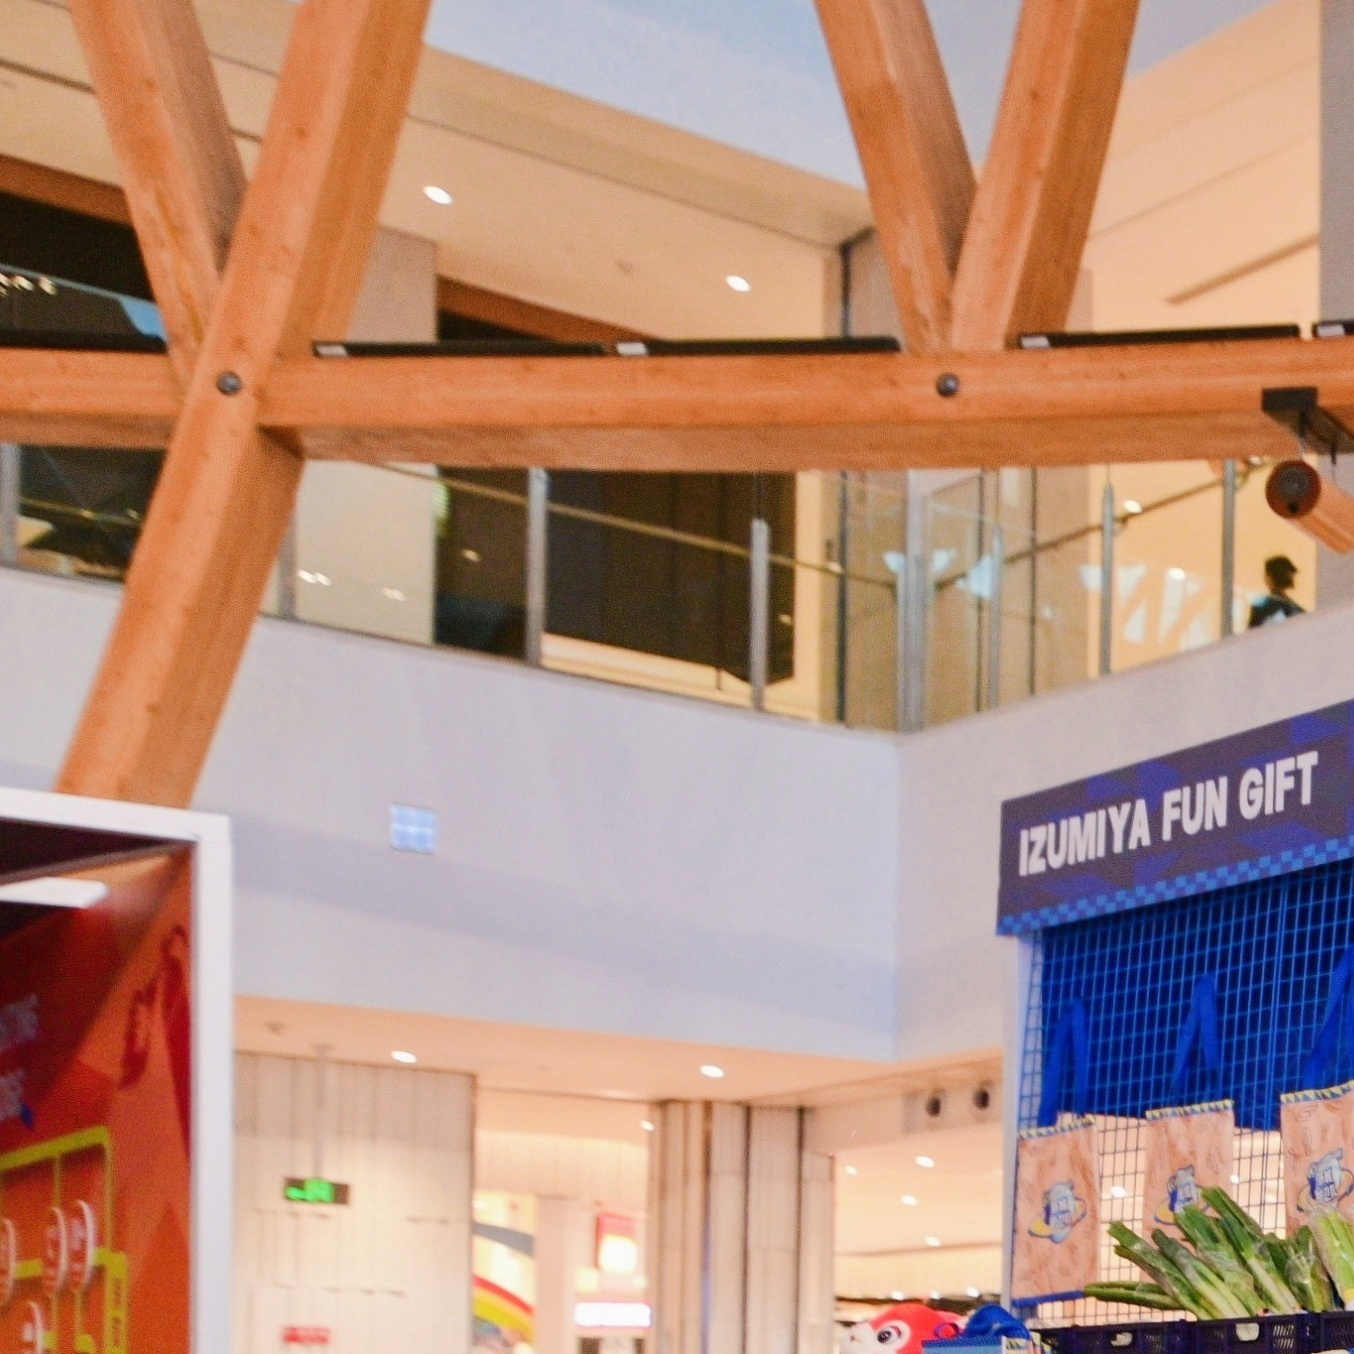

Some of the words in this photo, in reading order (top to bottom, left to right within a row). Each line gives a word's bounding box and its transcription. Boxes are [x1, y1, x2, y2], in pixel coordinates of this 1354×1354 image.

[1018, 797, 1152, 877] IZUMIYA
[1161, 774, 1229, 844] FUN
[1238, 750, 1319, 822] GIFT
